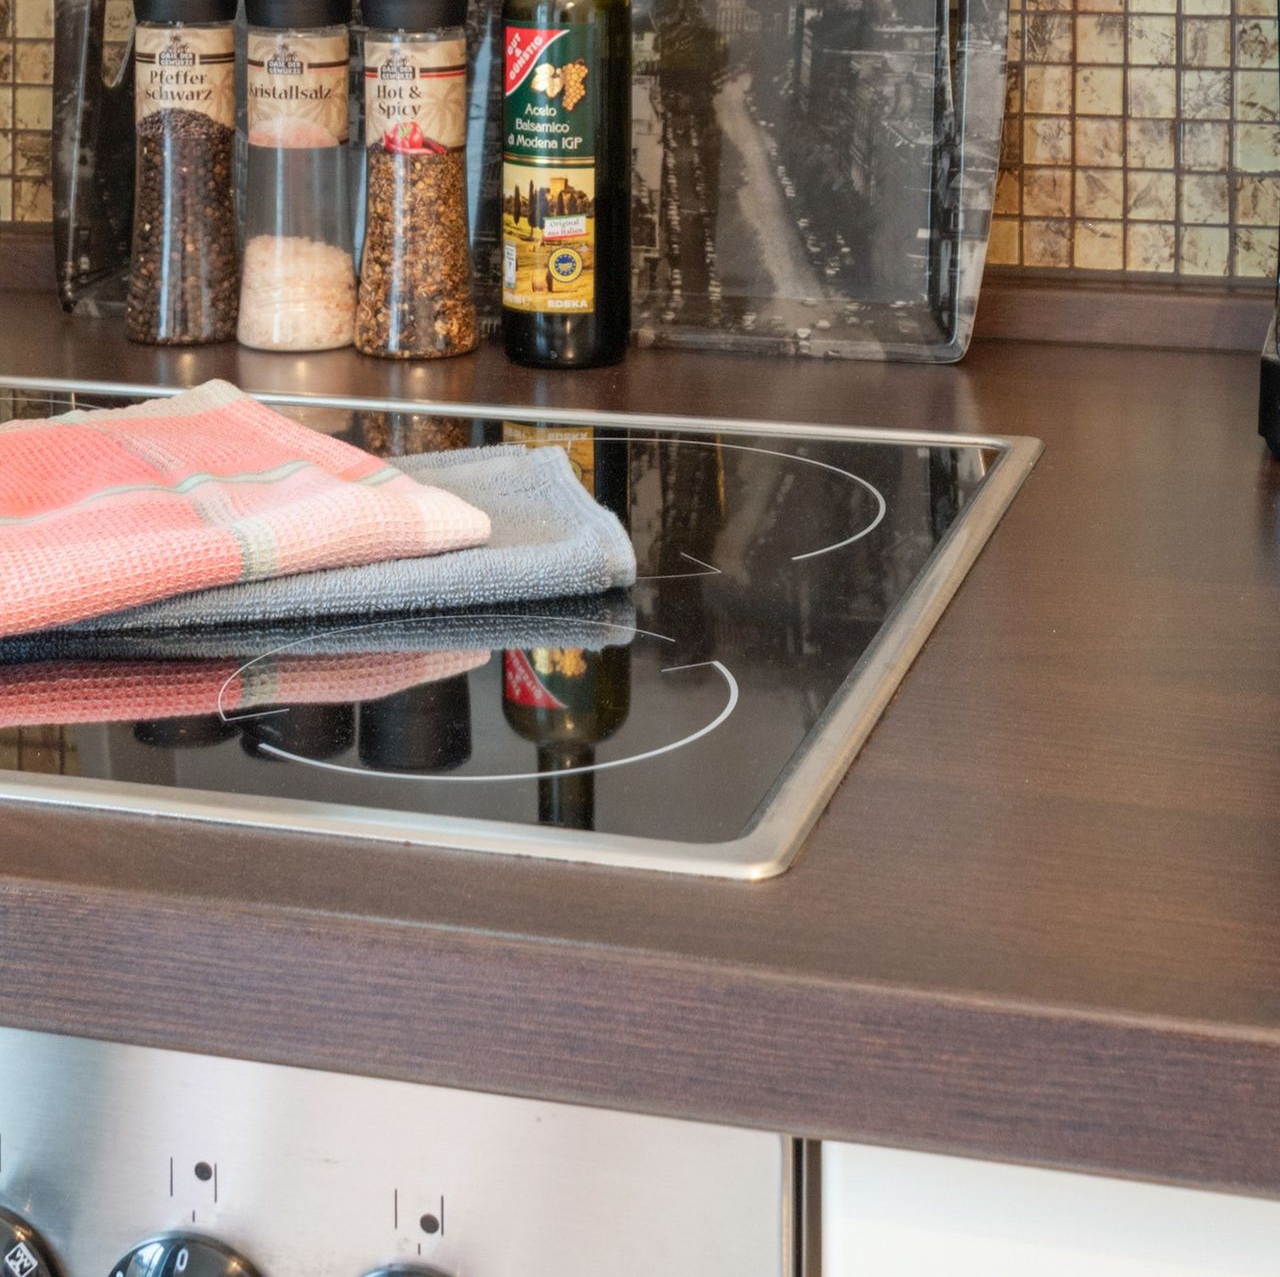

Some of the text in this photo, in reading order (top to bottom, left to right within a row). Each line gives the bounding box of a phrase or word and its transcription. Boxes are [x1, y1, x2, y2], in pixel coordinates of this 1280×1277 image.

[507, 32, 521, 56] GUT
[150, 69, 208, 84] Pfeffer
[145, 85, 213, 101] schwarz
[249, 83, 332, 100] Kristallsalz
[377, 84, 422, 99] Hot &
[378, 102, 422, 119] Spicy
[525, 103, 557, 117] Aceto
[515, 118, 570, 133] Balsamico
[516, 134, 558, 149] Modena
[561, 136, 583, 150] IGP
[547, 299, 588, 308] EDEKA
[175, 1248, 189, 1272] 0
